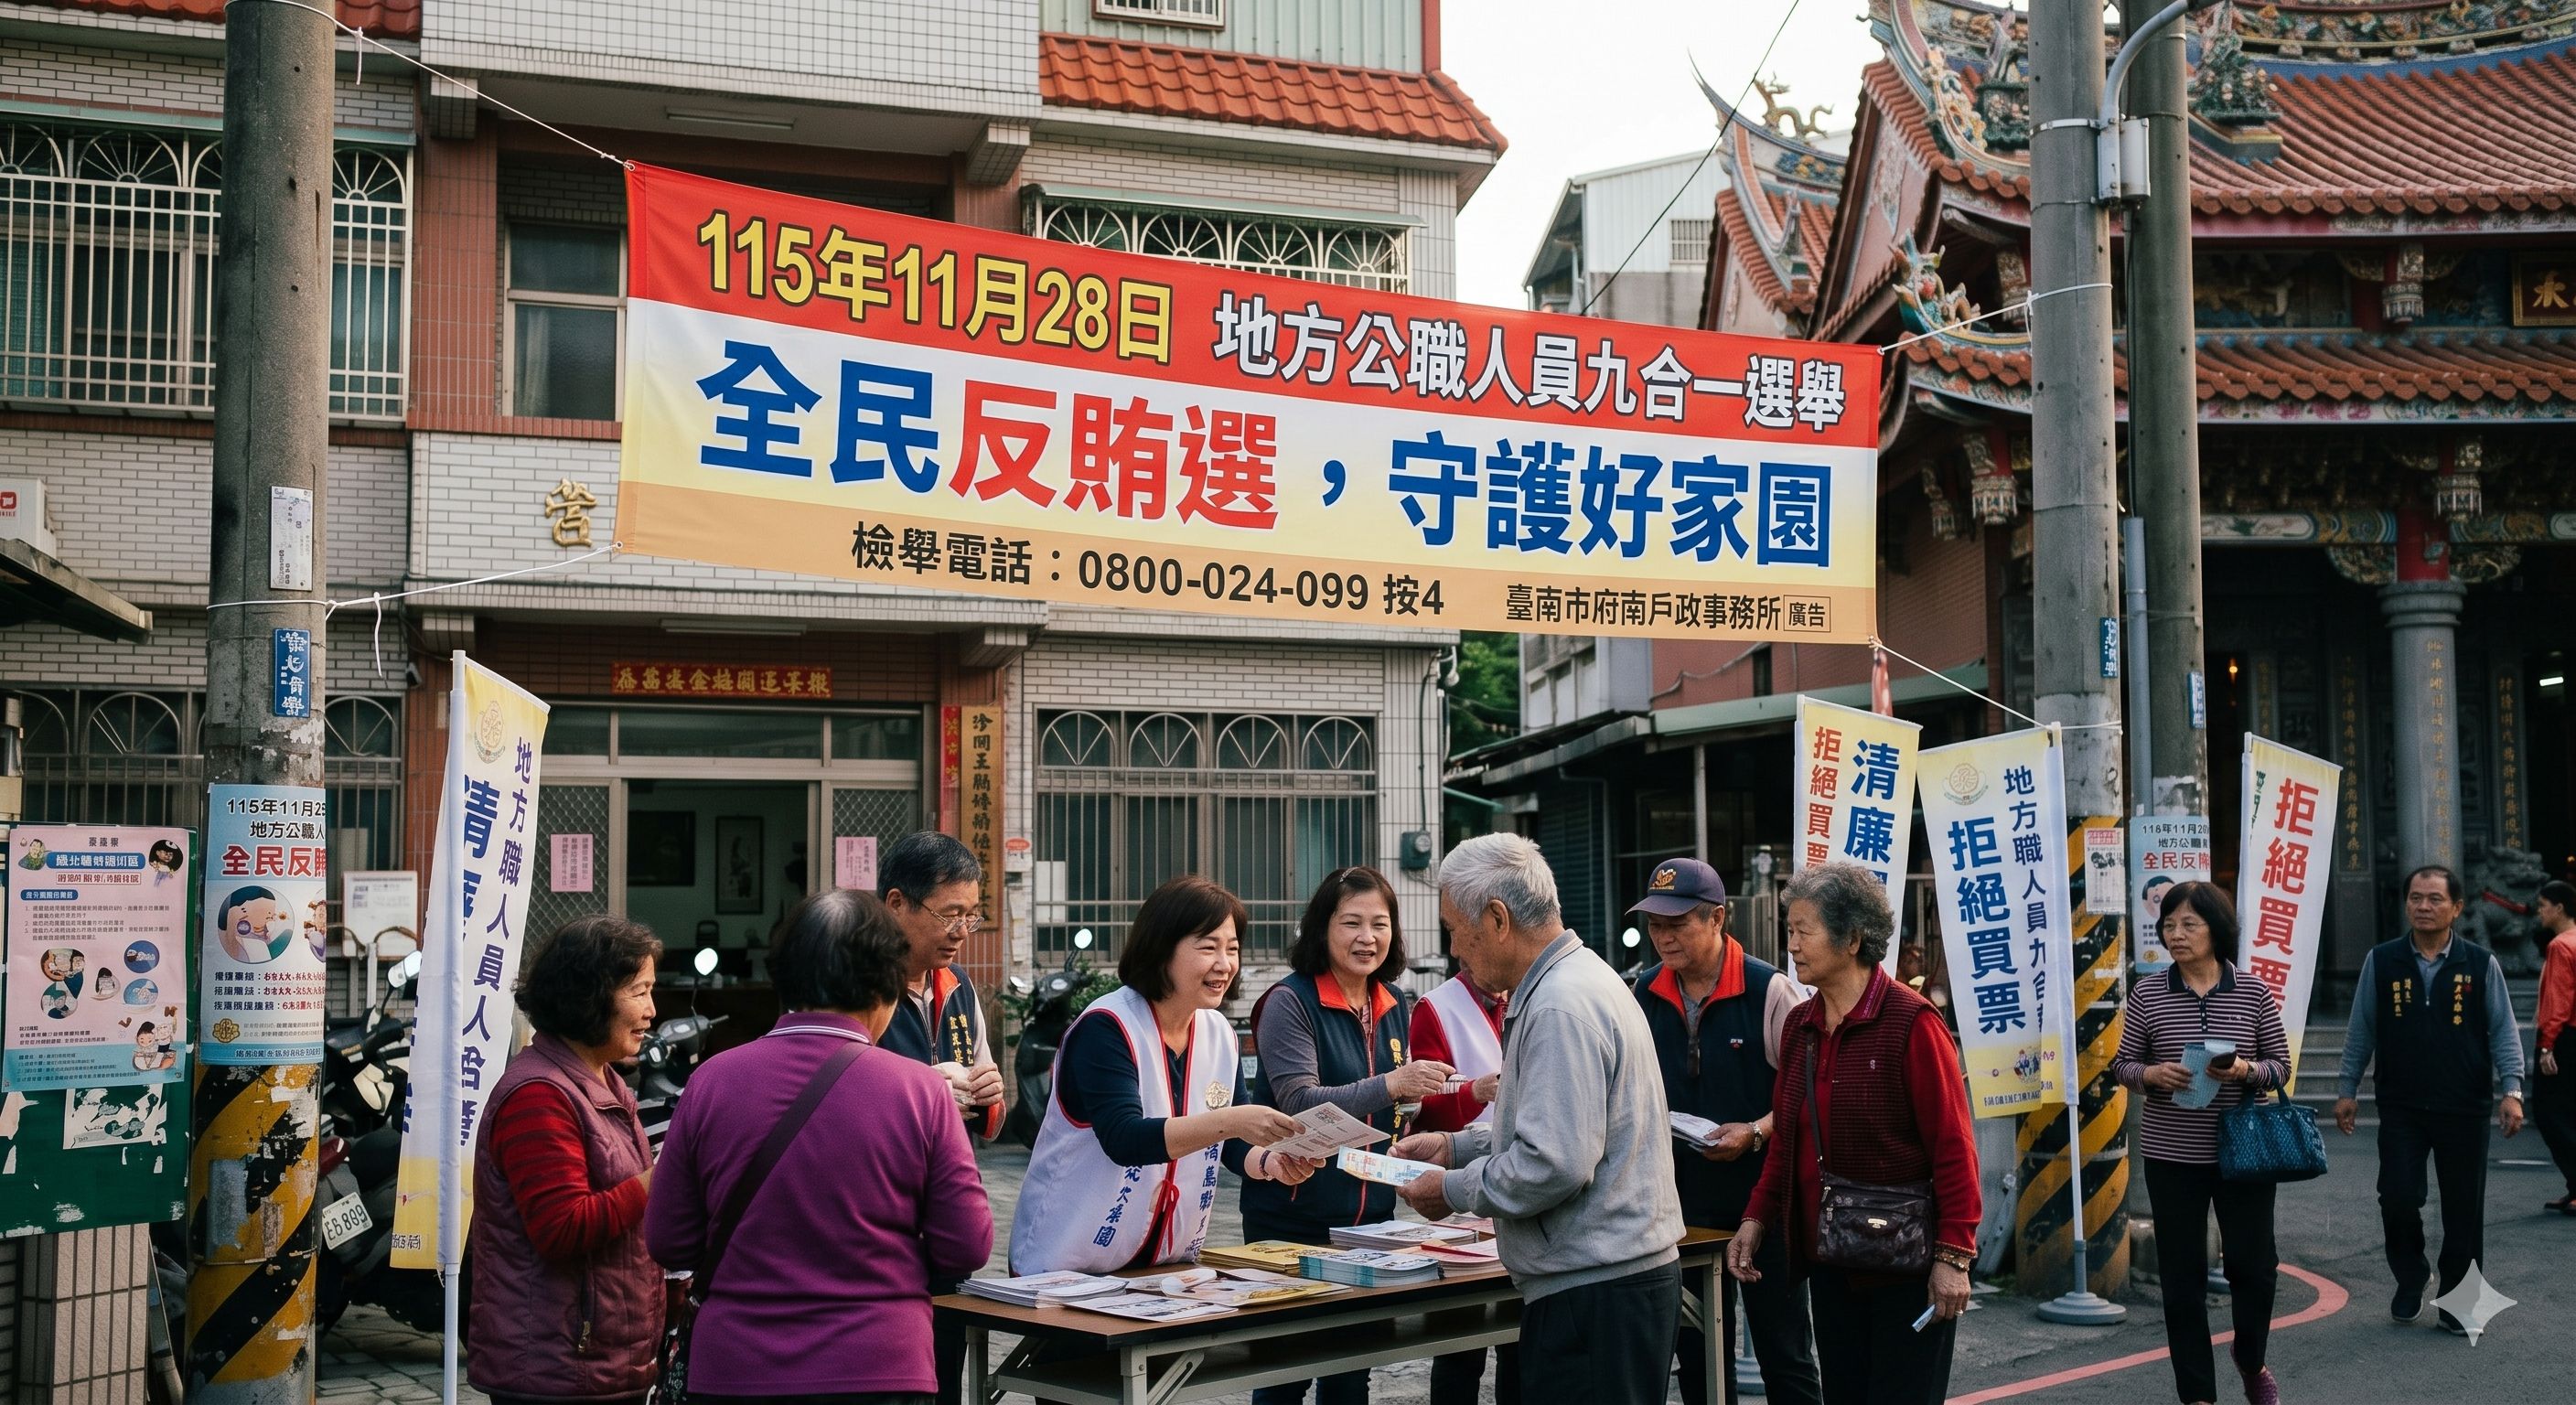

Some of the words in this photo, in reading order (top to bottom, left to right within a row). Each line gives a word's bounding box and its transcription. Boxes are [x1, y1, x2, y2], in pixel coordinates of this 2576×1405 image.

[698, 209, 1173, 364] 115年11月28日
[1212, 292, 1845, 432] 地方公職人員九合一選舉
[1383, 574, 1444, 617] 按4
[1506, 584, 1782, 631] 臺南市府南戶政事務所
[1788, 602, 1827, 628] 廣告
[1843, 739, 1900, 893] 清廉
[1948, 816, 2026, 1035] 拒絕買票
